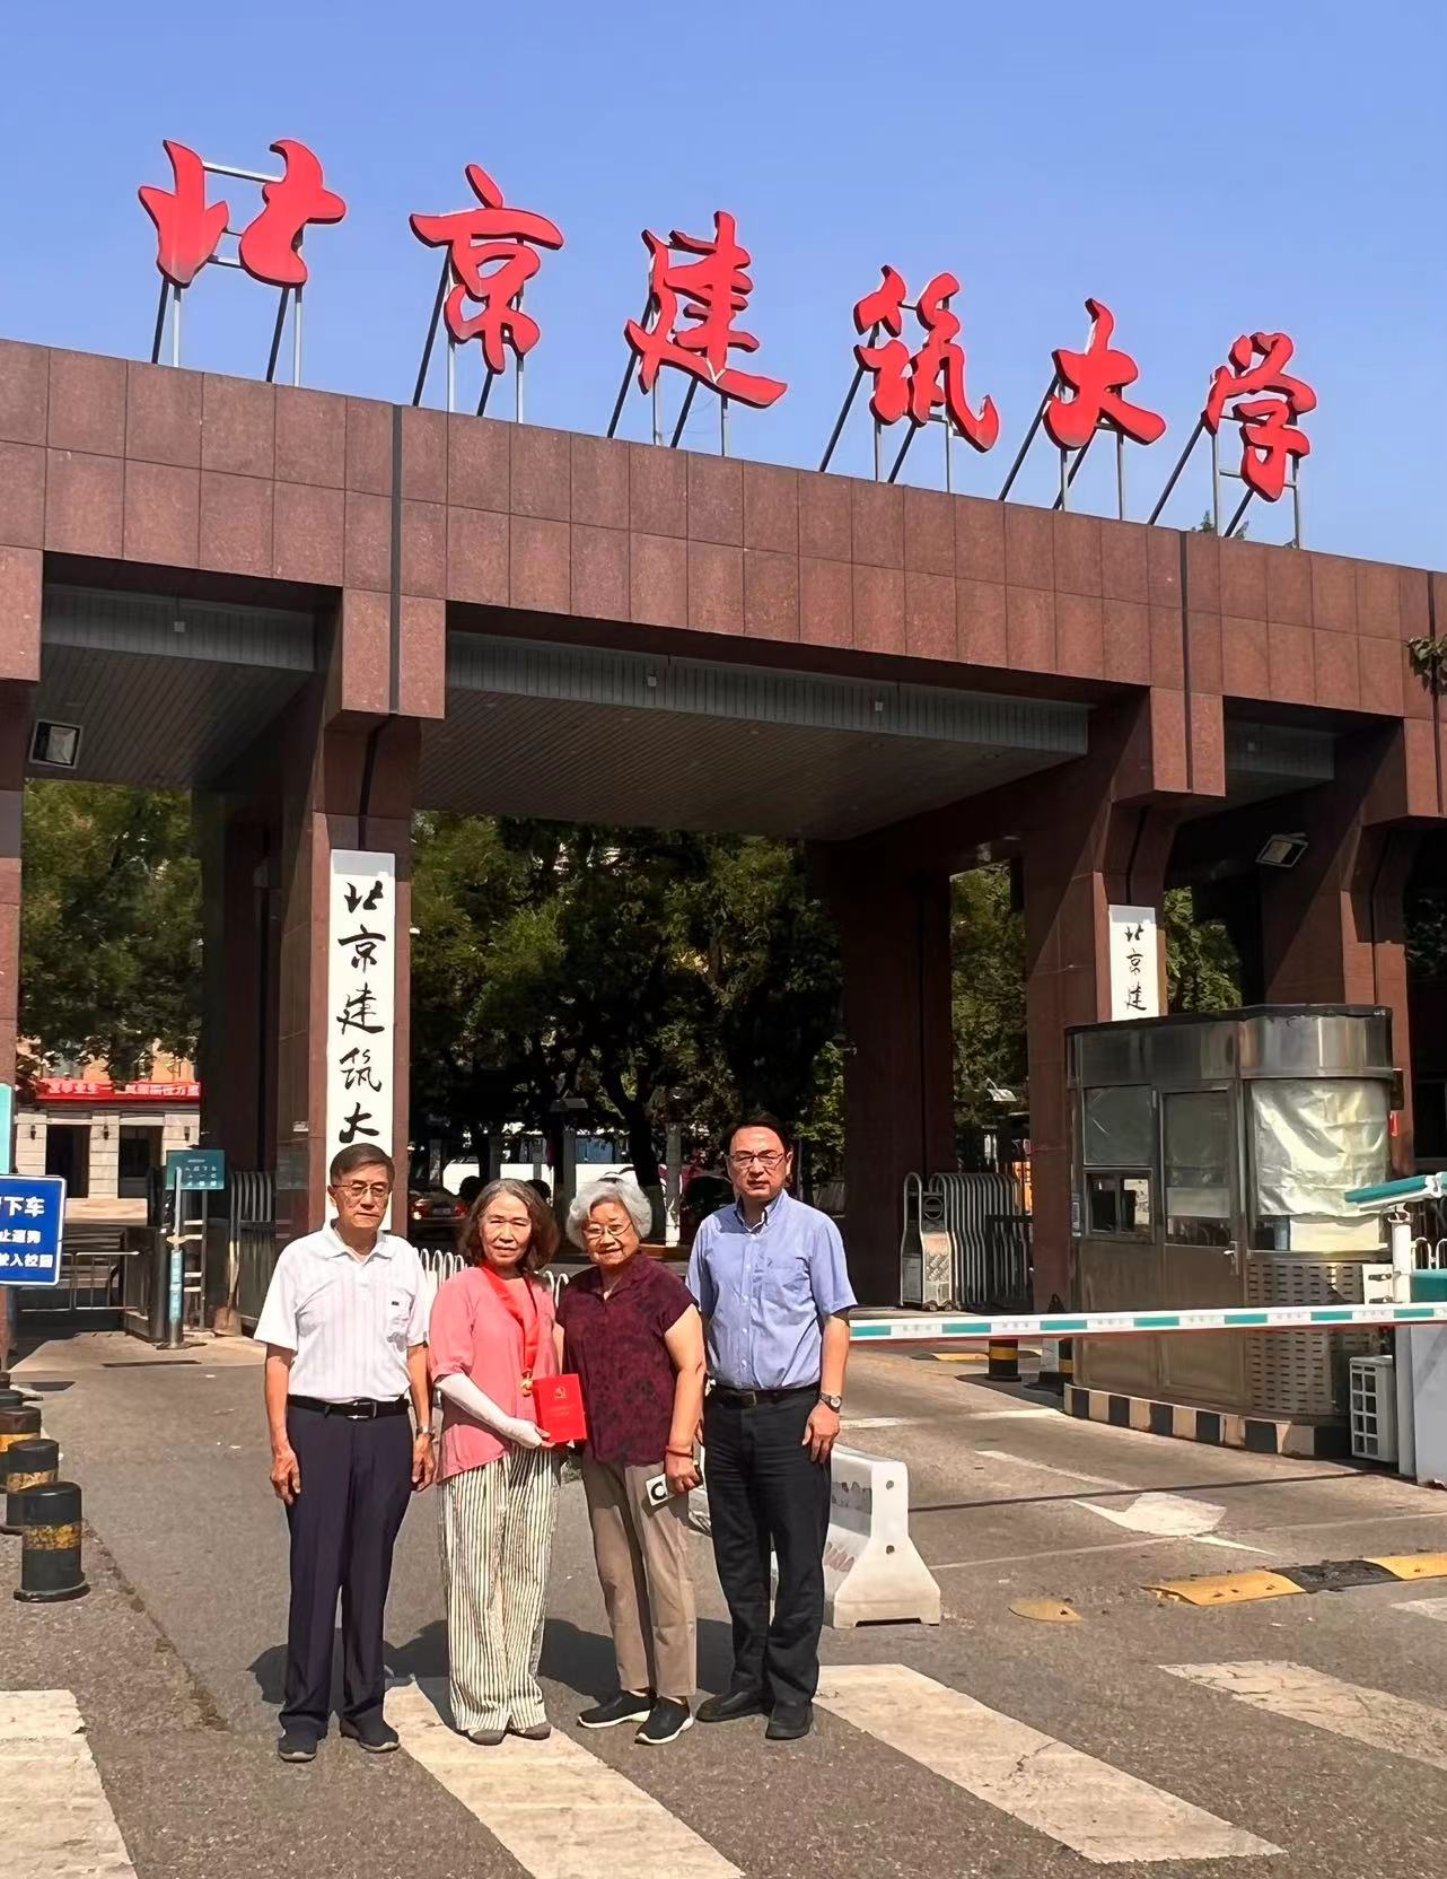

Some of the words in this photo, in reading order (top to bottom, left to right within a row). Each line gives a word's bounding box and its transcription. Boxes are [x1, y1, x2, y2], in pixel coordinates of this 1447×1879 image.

[139, 139, 1317, 502] 北京建筑大学
[336, 880, 386, 1144] 北京建筑大
[1124, 924, 1147, 1011] 北京建
[0, 1196, 45, 1217] 下车
